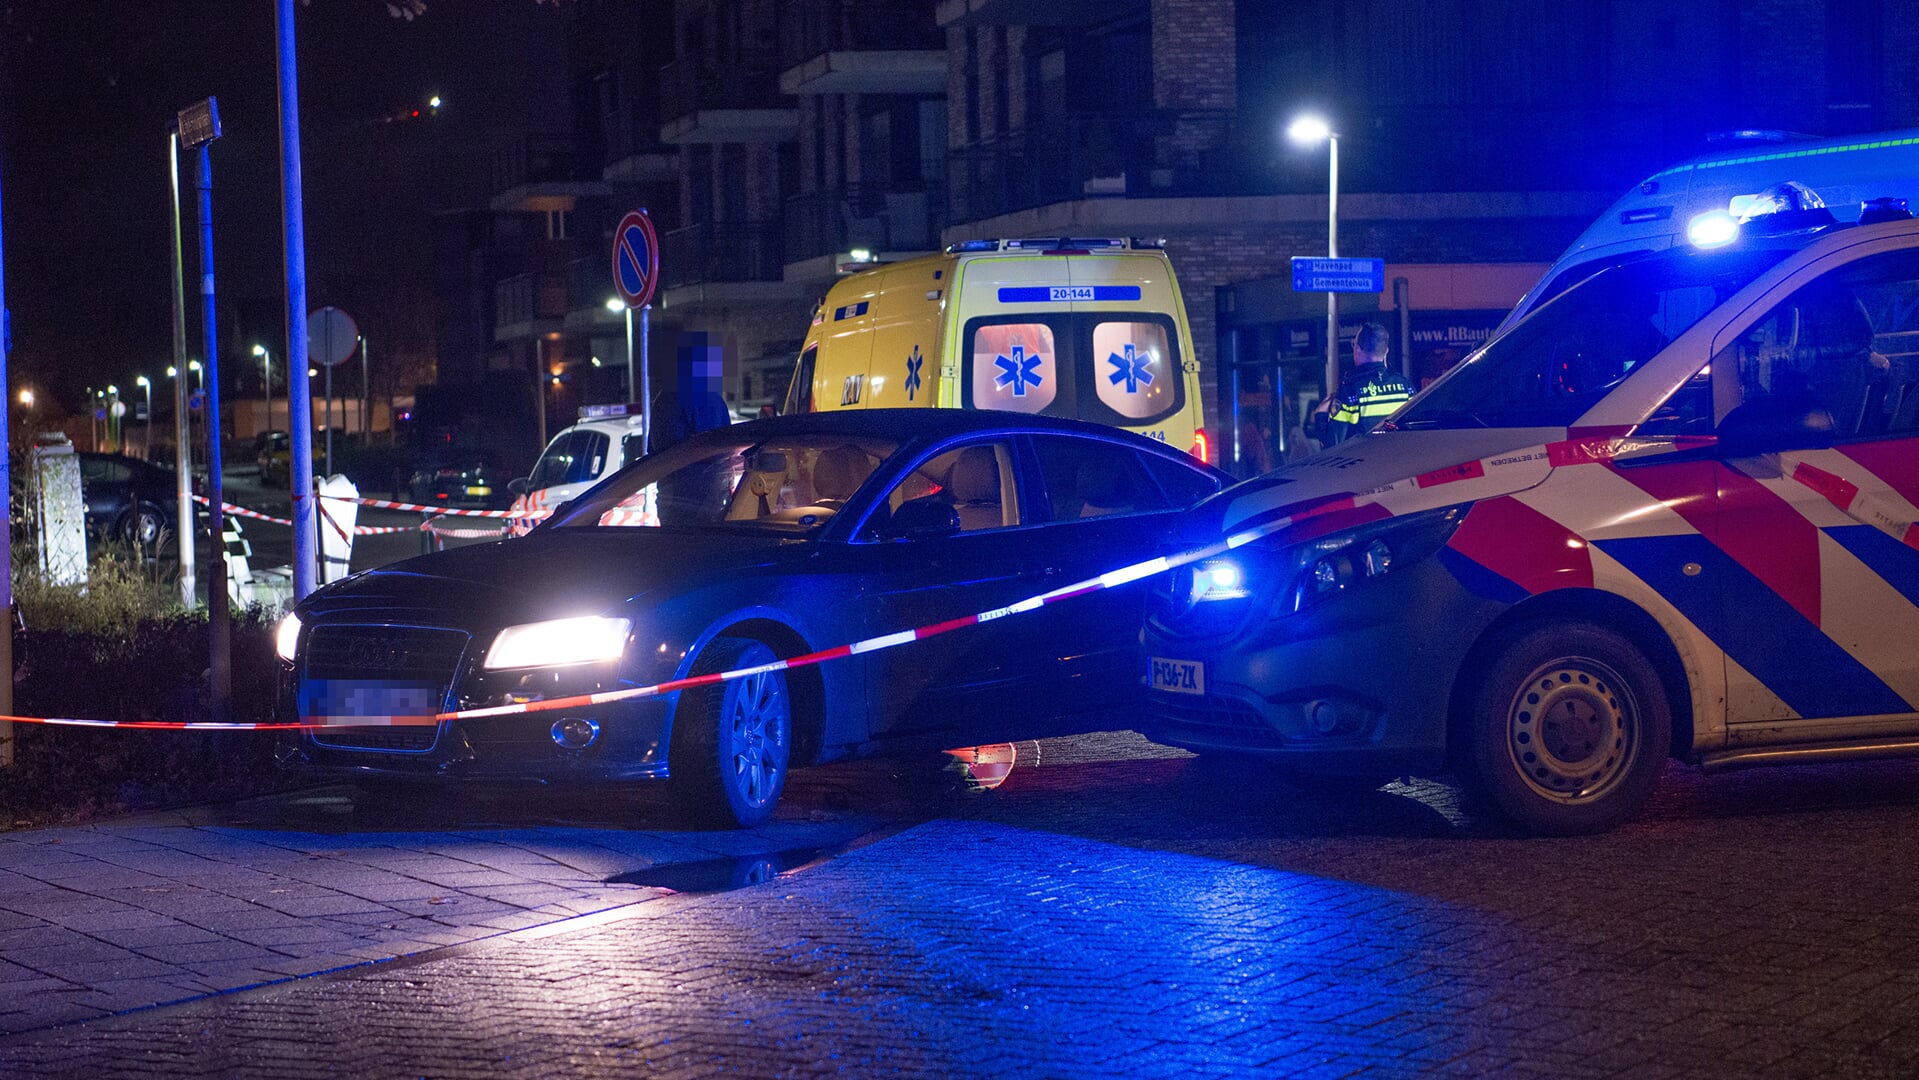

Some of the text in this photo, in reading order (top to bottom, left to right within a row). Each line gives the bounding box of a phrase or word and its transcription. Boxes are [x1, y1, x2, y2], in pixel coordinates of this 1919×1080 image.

[1314, 259, 1353, 271] Havenpad
[1314, 278, 1370, 288] Gemeentehuis
[1053, 288, 1092, 300] 20-144
[1490, 453, 1533, 466] BETREDEN
